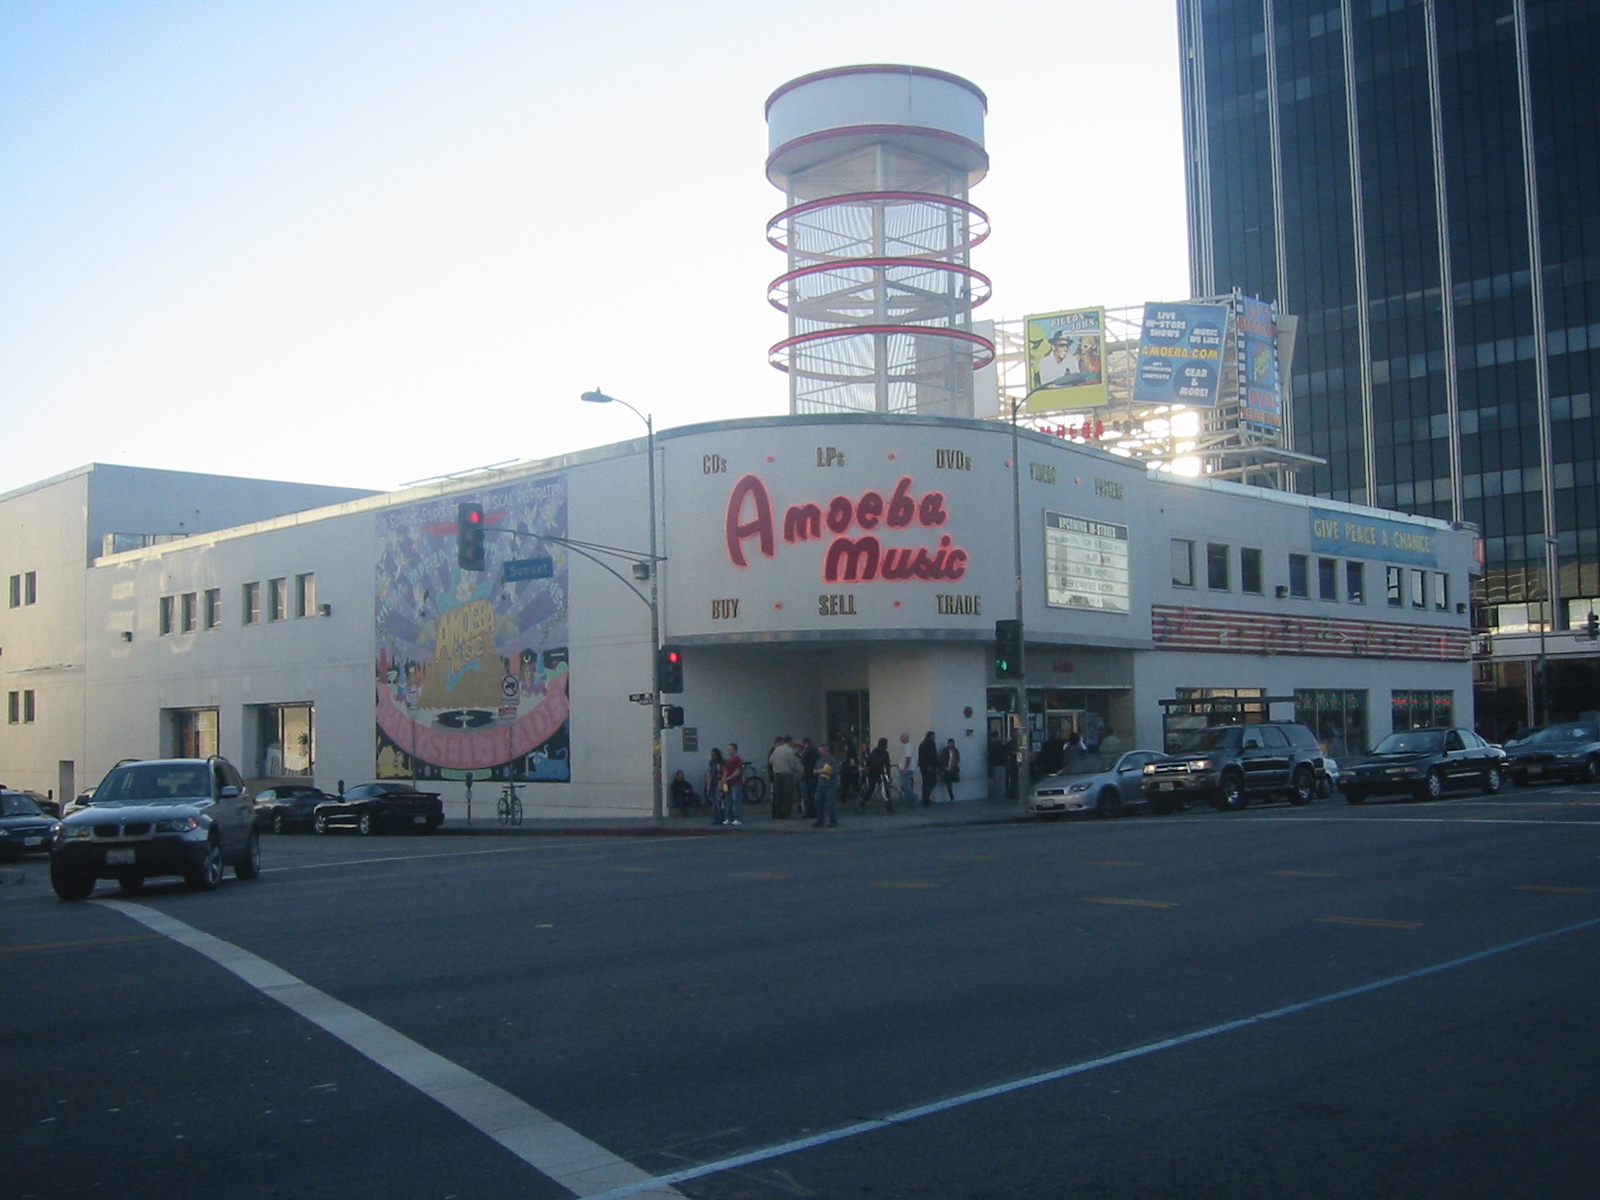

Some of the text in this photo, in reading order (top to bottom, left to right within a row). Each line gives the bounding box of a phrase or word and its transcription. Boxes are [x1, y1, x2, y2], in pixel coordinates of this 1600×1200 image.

[1051, 313, 1085, 328] PIGEON
[1157, 311, 1176, 320] LIVE
[1072, 319, 1095, 330] JOHN
[1145, 319, 1187, 329] IN-STORE
[1150, 329, 1181, 338] SHOWS
[1192, 328, 1218, 336] MUSIC
[1203, 336, 1220, 345] LIKE
[1141, 345, 1220, 360] AMOEBA.COM
[1184, 367, 1208, 377] GEAR
[1190, 377, 1199, 386] &
[1178, 387, 1209, 397] MORE!
[702, 454, 727, 474] CDs
[816, 446, 845, 467] LPs
[936, 448, 972, 470] DVDs
[726, 474, 947, 567] Amoeba
[1058, 516, 1087, 533] UPCOMING
[1314, 518, 1340, 540] GIVE
[1345, 521, 1377, 546] PEACE
[1382, 529, 1389, 546] A
[824, 534, 970, 584] Music
[510, 564, 548, 577] Sunset
[712, 598, 739, 620] BUY
[818, 595, 857, 616] SELL
[937, 594, 981, 616] TRADE
[435, 599, 495, 663] AMOEBA
